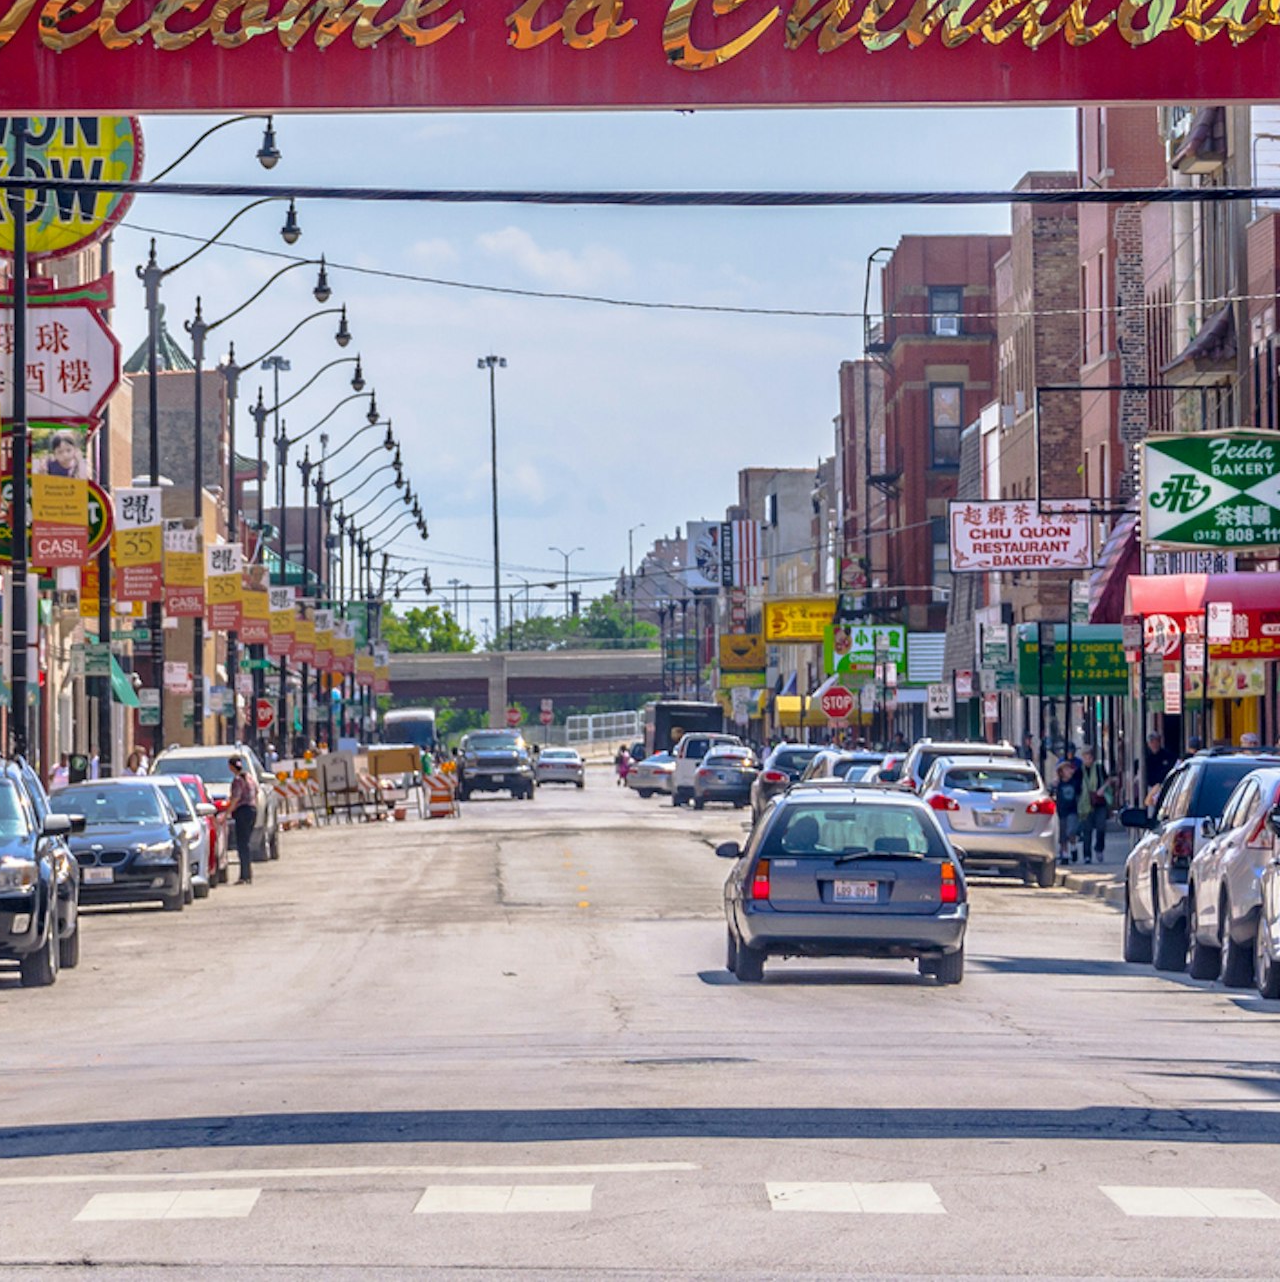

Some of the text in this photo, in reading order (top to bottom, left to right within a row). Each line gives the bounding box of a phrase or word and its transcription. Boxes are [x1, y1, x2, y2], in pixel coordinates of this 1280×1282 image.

[1208, 438, 1276, 463] Feida
[1211, 463, 1275, 476] BAKERY
[969, 526, 1072, 539] CHIU QUON
[1193, 529, 1222, 541] (312)
[37, 539, 83, 555] CASL
[124, 531, 153, 556] 35
[972, 541, 1070, 554] RESTAURANT
[993, 555, 1052, 566] BAKERY
[823, 696, 851, 710] STOP
